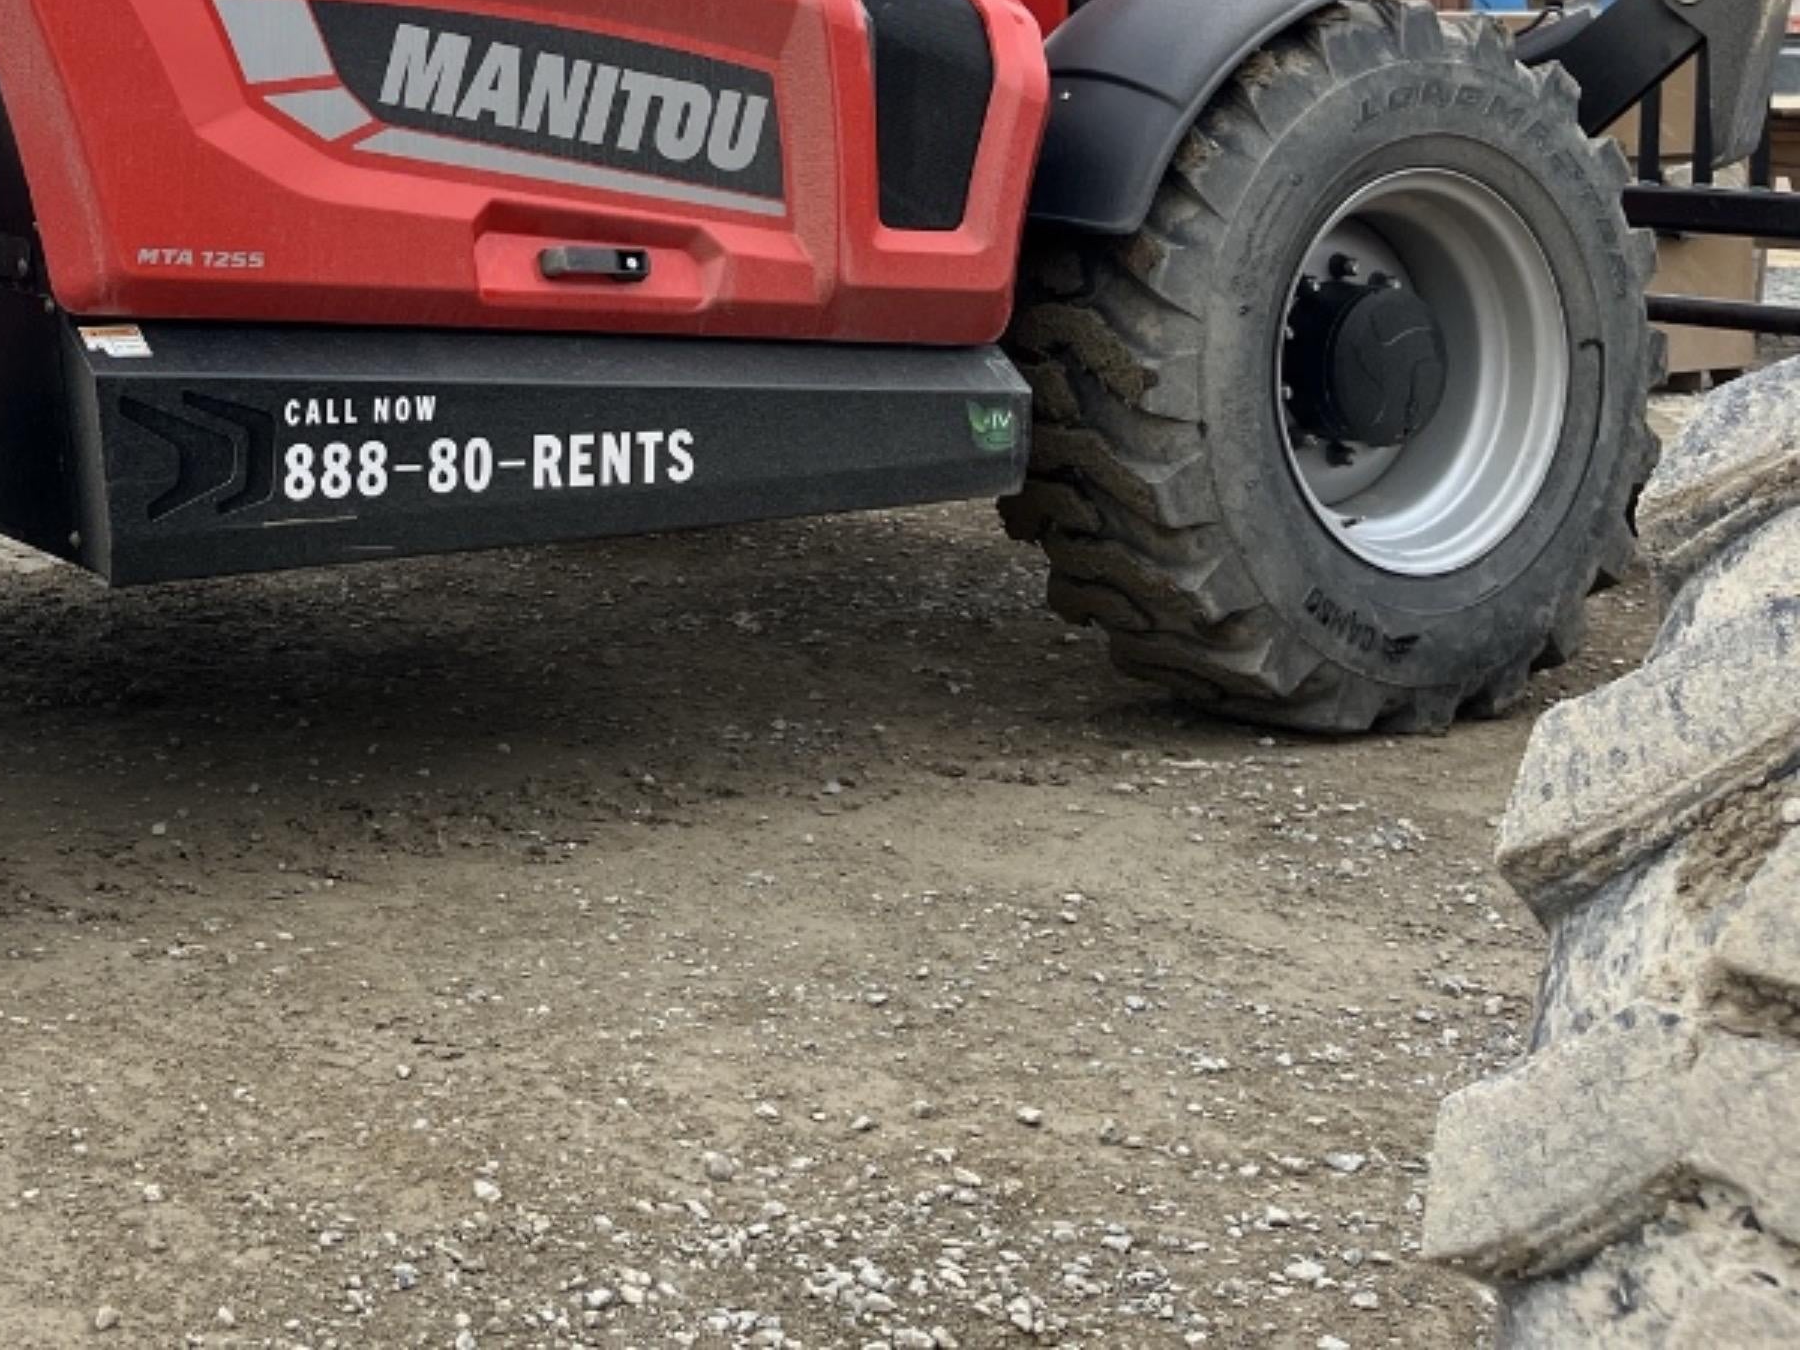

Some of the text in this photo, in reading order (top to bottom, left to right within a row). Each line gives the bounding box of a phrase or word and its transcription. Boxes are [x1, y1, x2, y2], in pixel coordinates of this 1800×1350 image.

[378, 23, 770, 171] MANITOU
[135, 247, 265, 269] MTA 1255
[284, 395, 436, 426] CALL NOW
[284, 428, 695, 501] 888-80-RENTS
